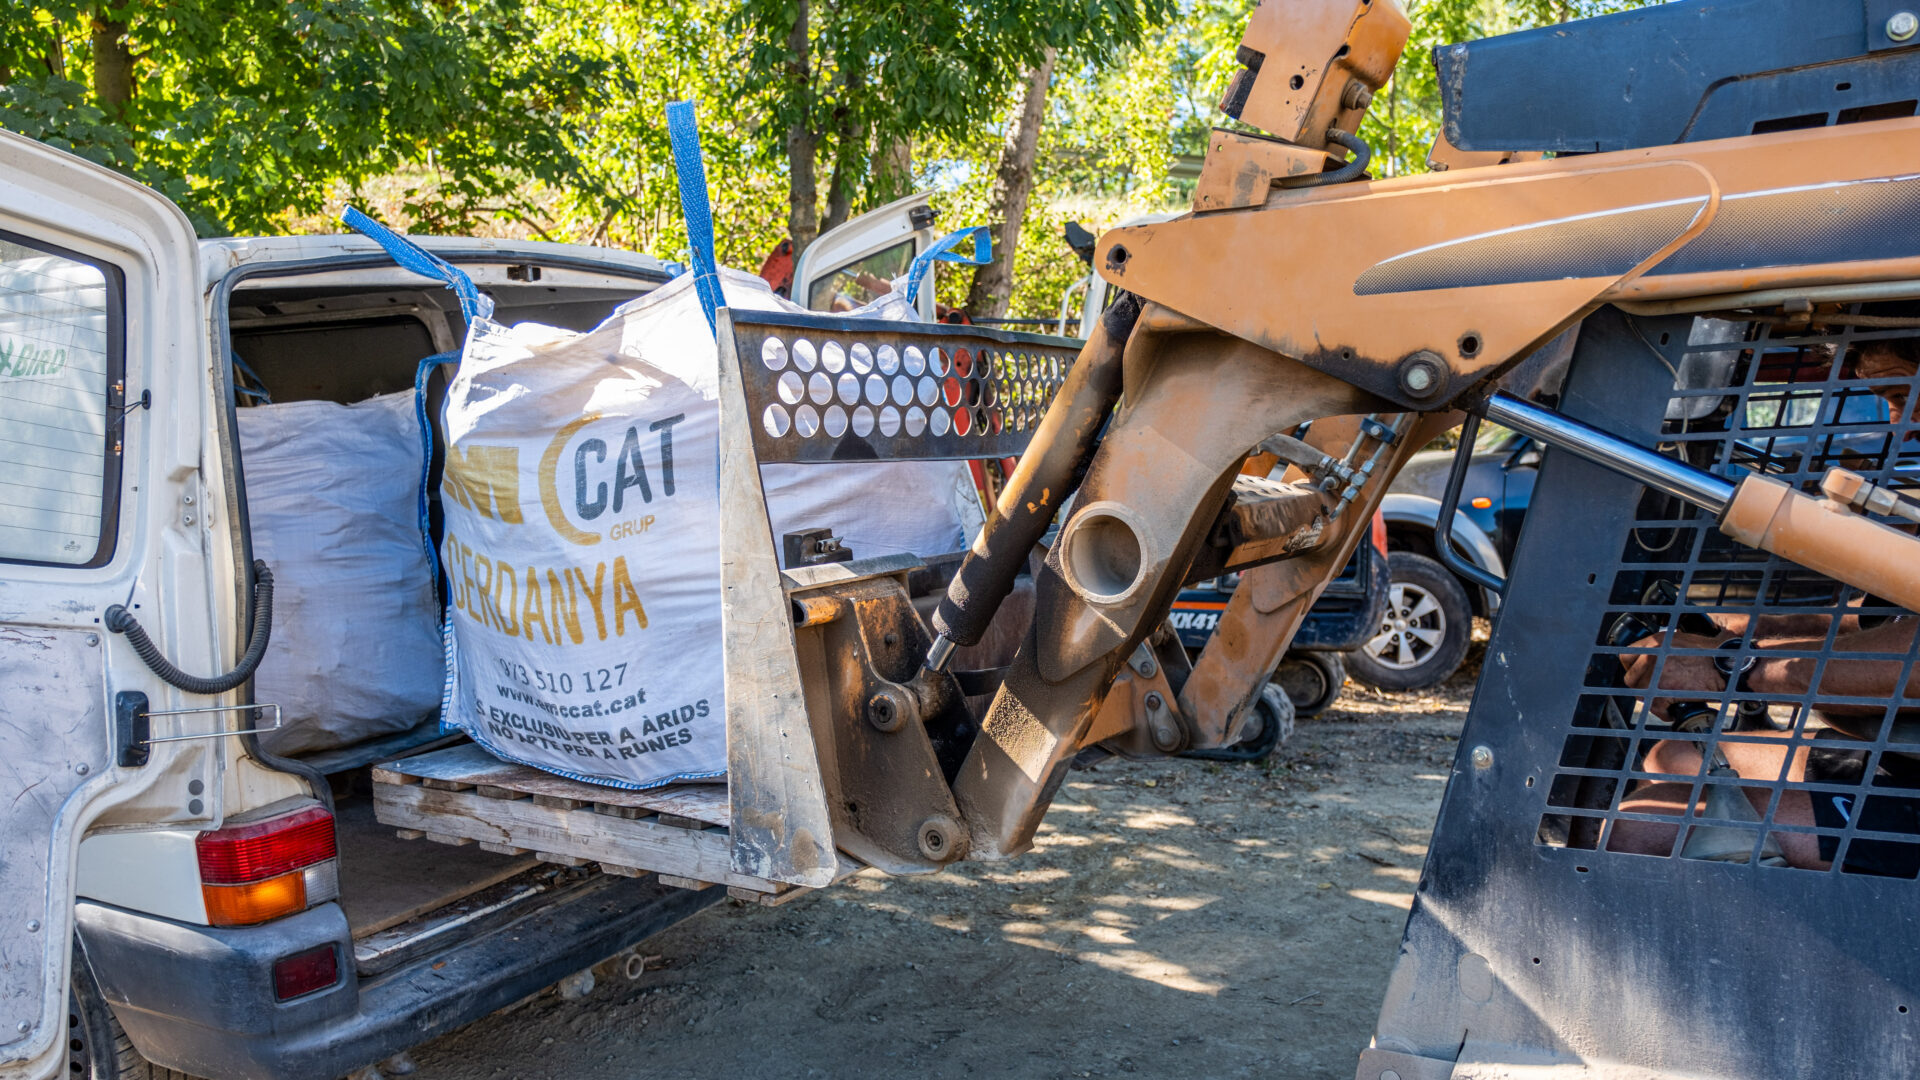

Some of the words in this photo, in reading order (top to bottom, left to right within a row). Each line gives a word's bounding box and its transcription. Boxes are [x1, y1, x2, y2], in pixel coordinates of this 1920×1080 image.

[574, 412, 685, 521] CAT
[609, 515, 656, 541] GRUP
[447, 531, 648, 646] CERDANYA
[535, 669, 573, 694] 510
[583, 662, 628, 693] 127
[488, 721, 514, 740] NO
[602, 747, 617, 760] A
[618, 727, 693, 760] RUNES
[571, 731, 614, 745] PER
[620, 726, 636, 744] A
[642, 699, 710, 737] ÀRIDS
